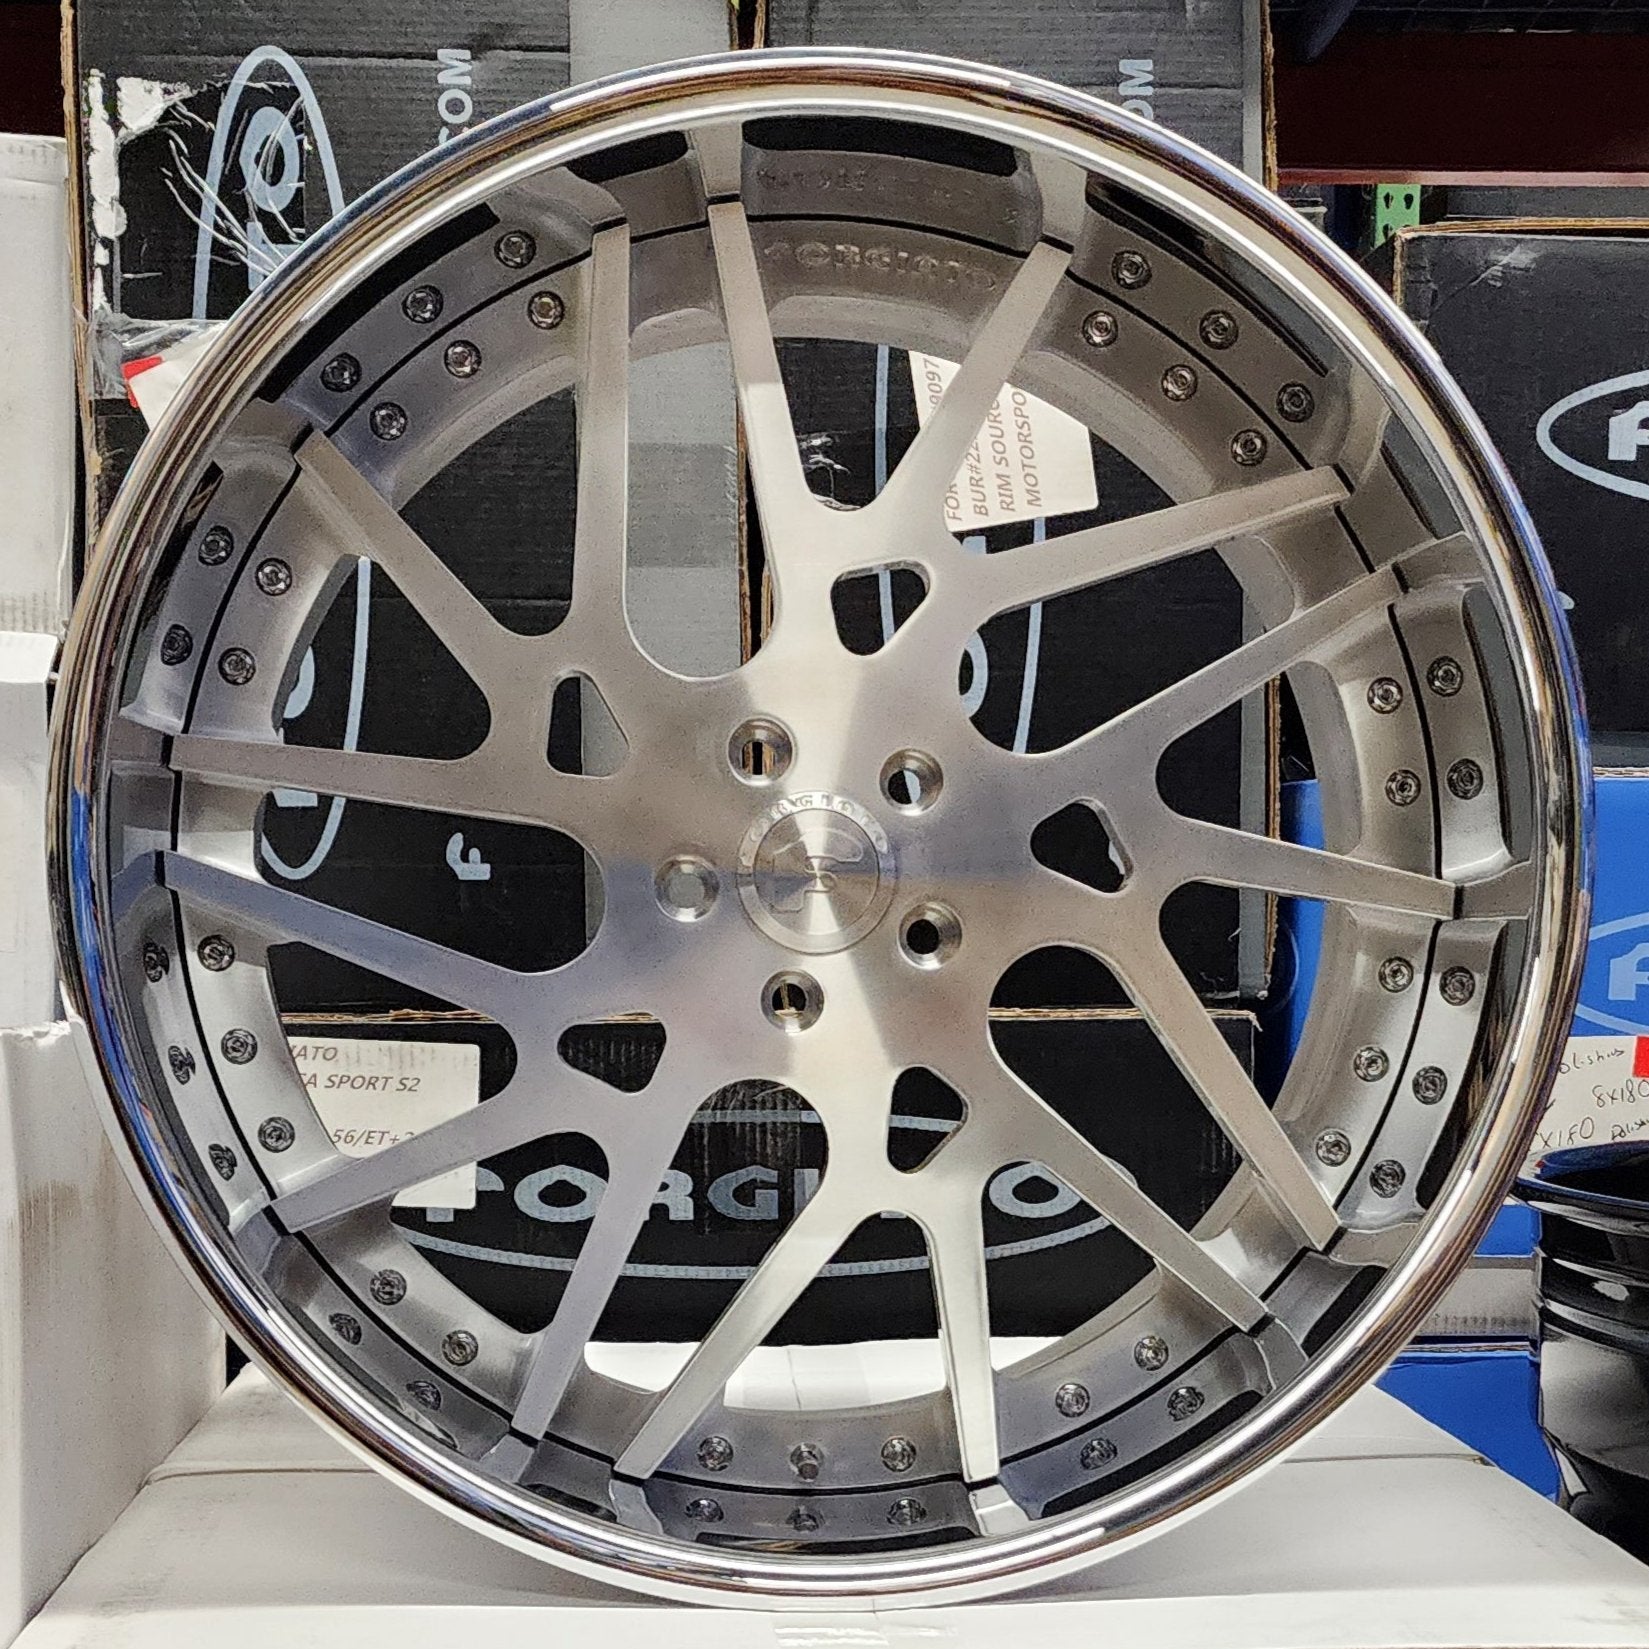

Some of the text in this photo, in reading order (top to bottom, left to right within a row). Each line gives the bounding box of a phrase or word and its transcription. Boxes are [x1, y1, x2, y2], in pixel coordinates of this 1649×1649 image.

[995, 473, 1016, 512] RIM
[325, 1074, 393, 1091] SPORT
[396, 1077, 421, 1092] S2
